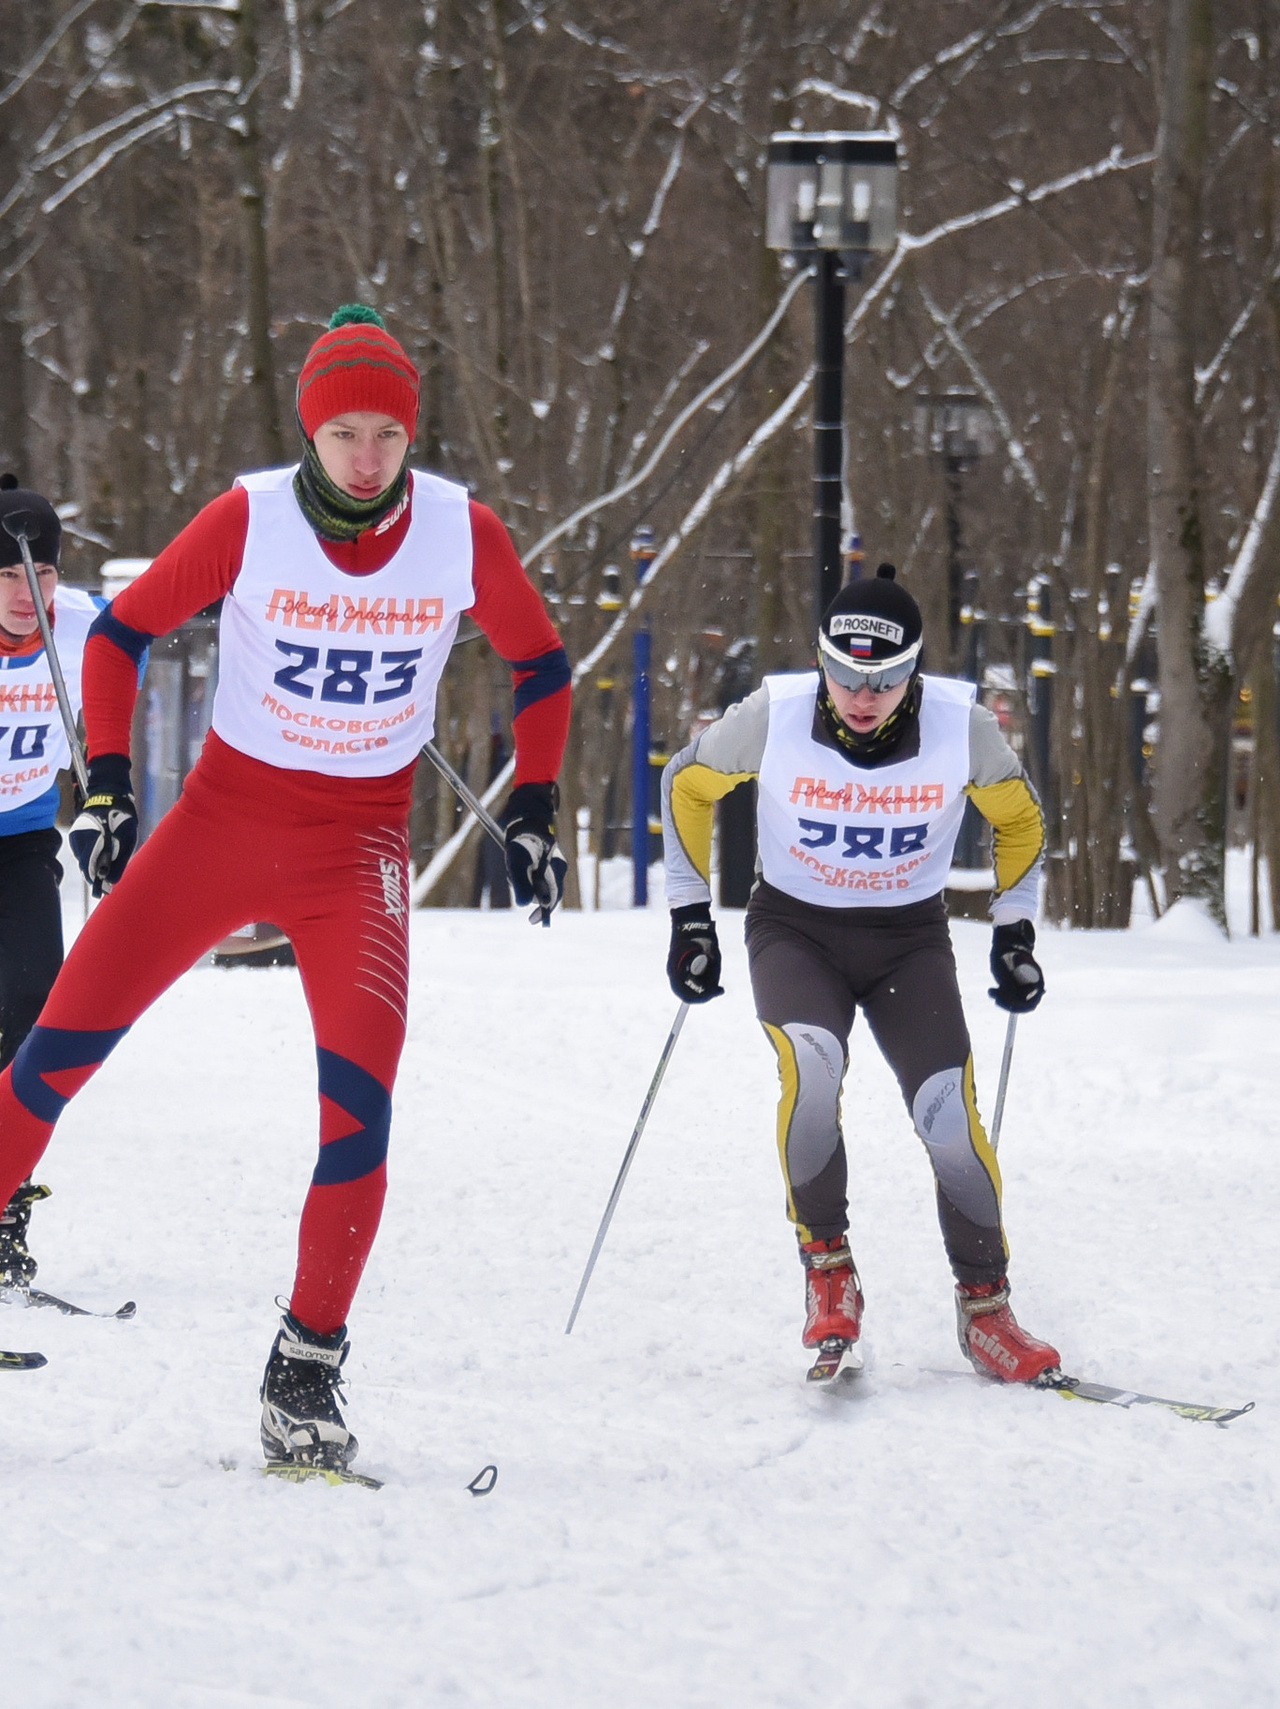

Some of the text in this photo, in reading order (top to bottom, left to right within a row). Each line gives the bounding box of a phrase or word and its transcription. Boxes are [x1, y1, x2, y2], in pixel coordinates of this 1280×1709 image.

[265, 588, 444, 636] ЛЫЖНЯ
[843, 617, 900, 640] ROSNEFT
[273, 638, 424, 705] 283
[260, 691, 416, 734] МОСКОВСКАЯ
[789, 777, 944, 815] ЛЫЖНЯ
